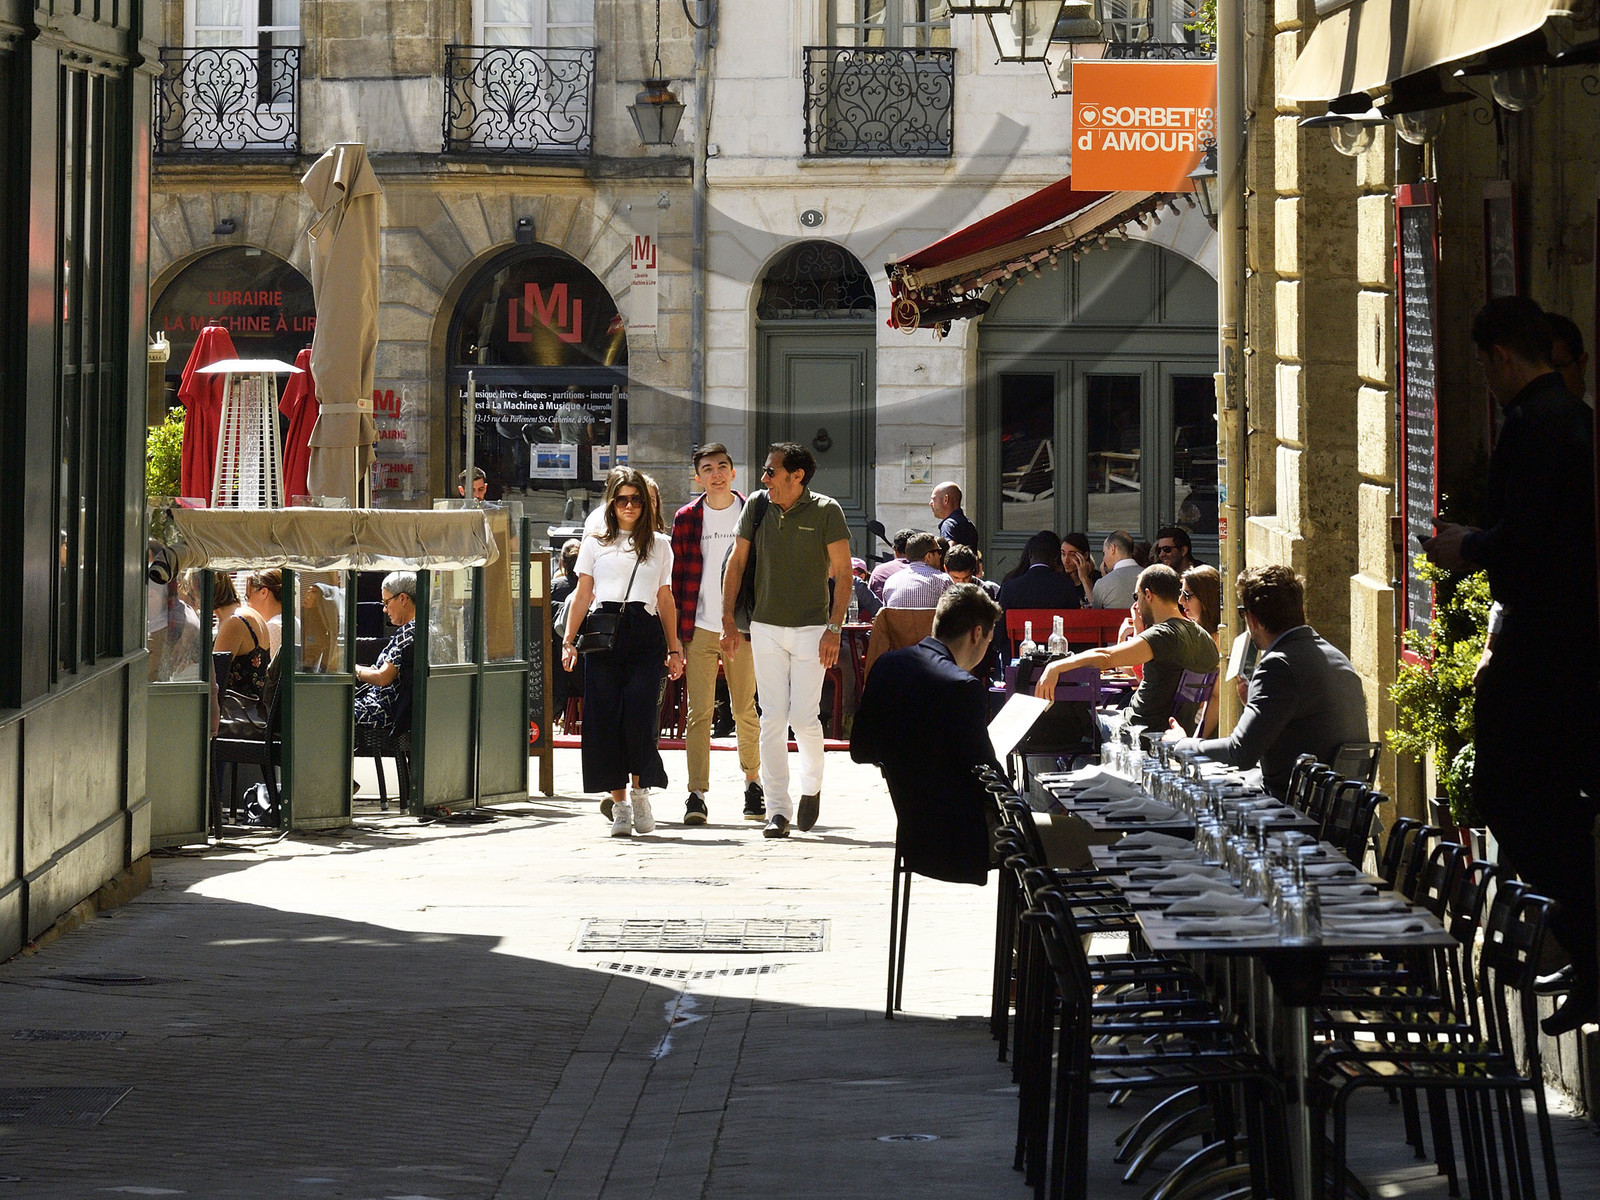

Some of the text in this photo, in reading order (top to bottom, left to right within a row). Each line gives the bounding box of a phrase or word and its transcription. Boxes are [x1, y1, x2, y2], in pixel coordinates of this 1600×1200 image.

[1101, 106, 1195, 127] SORBET
[808, 213, 814, 224] 9
[208, 290, 283, 306] LIBRAIRIE
[164, 315, 185, 331] LA
[275, 312, 288, 332] À
[293, 316, 317, 332] LIR
[474, 389, 499, 401] usique,
[499, 389, 518, 399] livres
[522, 390, 547, 401] disques
[552, 390, 585, 401] partitions
[590, 390, 629, 400] instrunts
[492, 401, 502, 410] La
[503, 401, 538, 410] Machine
[539, 401, 545, 410] à
[545, 401, 581, 412] Musique
[501, 415, 509, 423] du
[509, 414, 538, 423] Parlement
